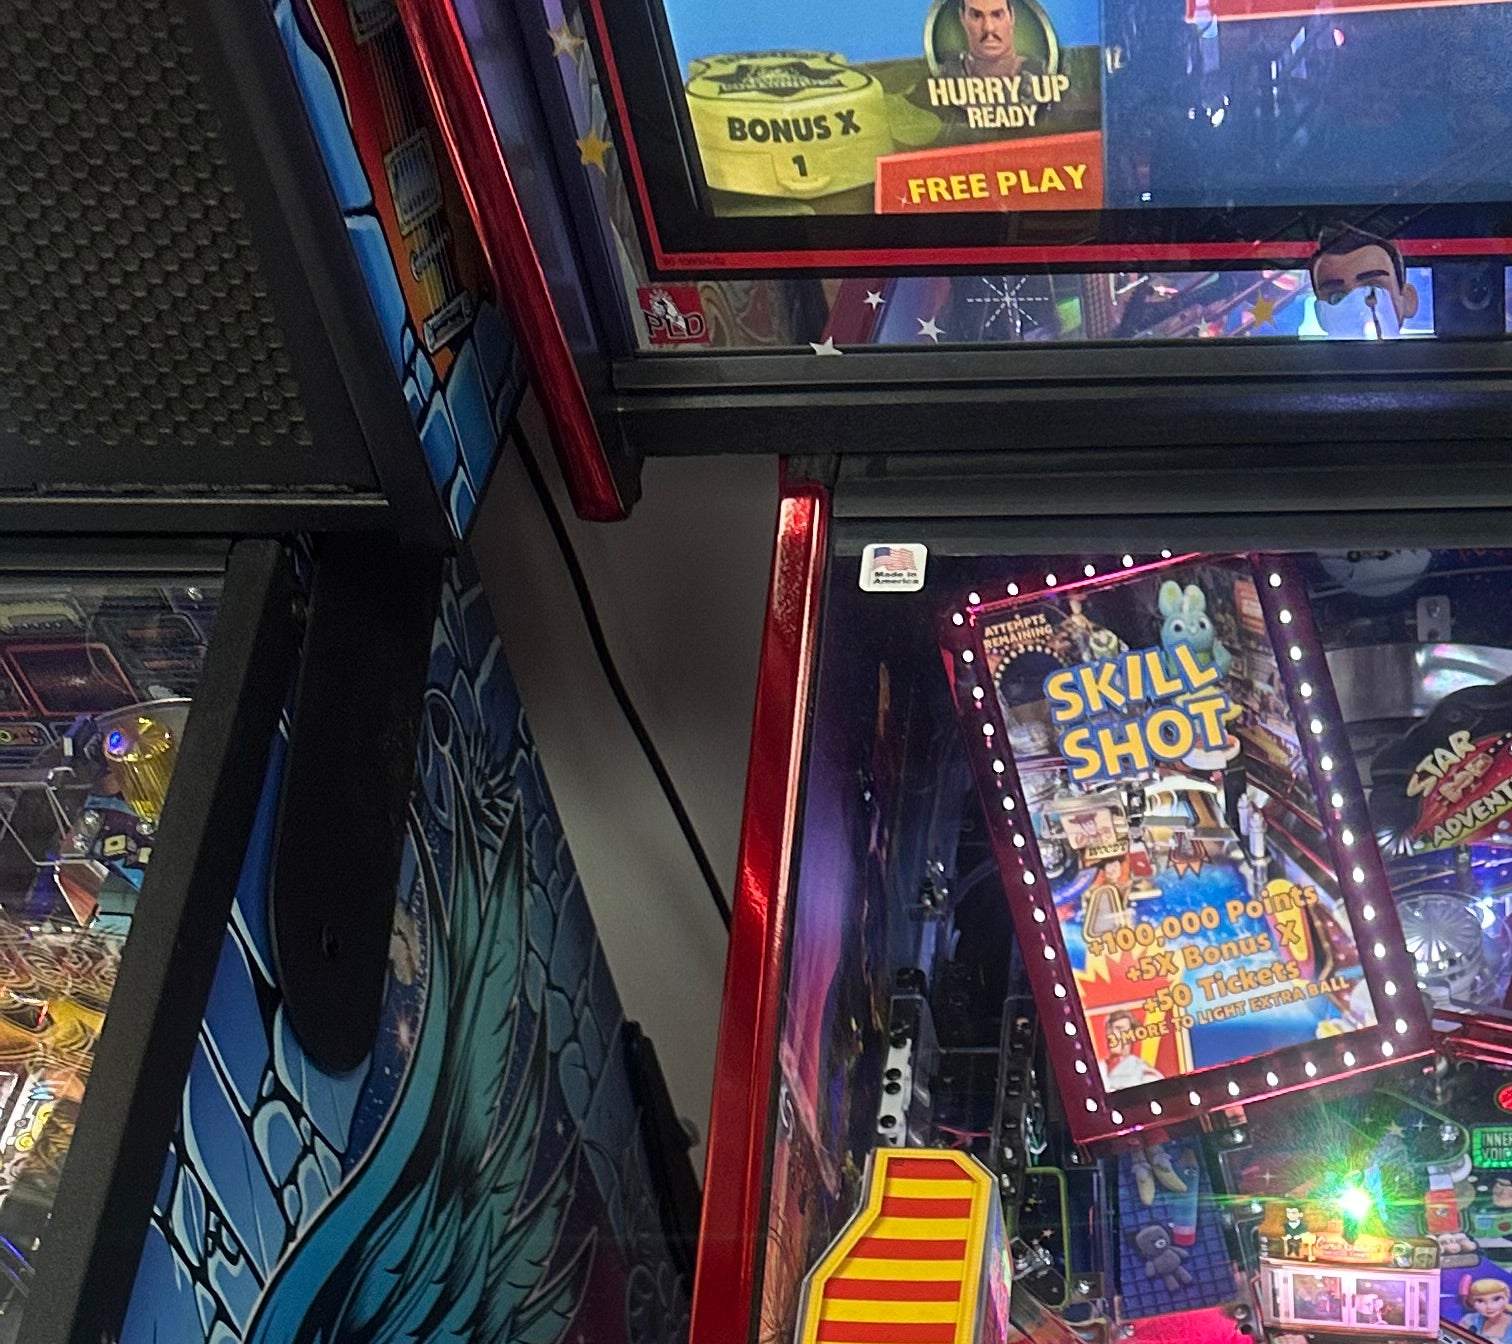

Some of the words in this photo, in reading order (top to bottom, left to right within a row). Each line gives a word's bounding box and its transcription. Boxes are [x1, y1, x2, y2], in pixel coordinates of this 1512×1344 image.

[928, 77, 1018, 106] HURRY
[1031, 75, 1070, 103] UP
[727, 115, 832, 143] BONUS
[835, 109, 861, 136] X
[967, 105, 1038, 129] READY
[791, 154, 808, 177] 1
[908, 172, 989, 203] FREE
[997, 164, 1088, 196] PLAY
[983, 623, 1054, 649] REMAINING
[984, 613, 1047, 637] ATTEMPTS
[1044, 642, 1222, 724] SKILL
[1061, 700, 1230, 782] SHOT
[1406, 730, 1477, 798] STAR
[1088, 906, 1220, 957] +100,000
[1225, 884, 1318, 924] Points
[1182, 932, 1272, 970] Bonus
[1275, 919, 1301, 947] X
[1121, 1023, 1171, 1046] MORE
[1171, 1014, 1195, 1033] TO
[1197, 1002, 1248, 1026] LIGHT
[1249, 988, 1306, 1014] EXTRA
[1306, 975, 1350, 999] BALL
[1142, 983, 1193, 1016] +50
[1197, 960, 1301, 1002] Tickets
